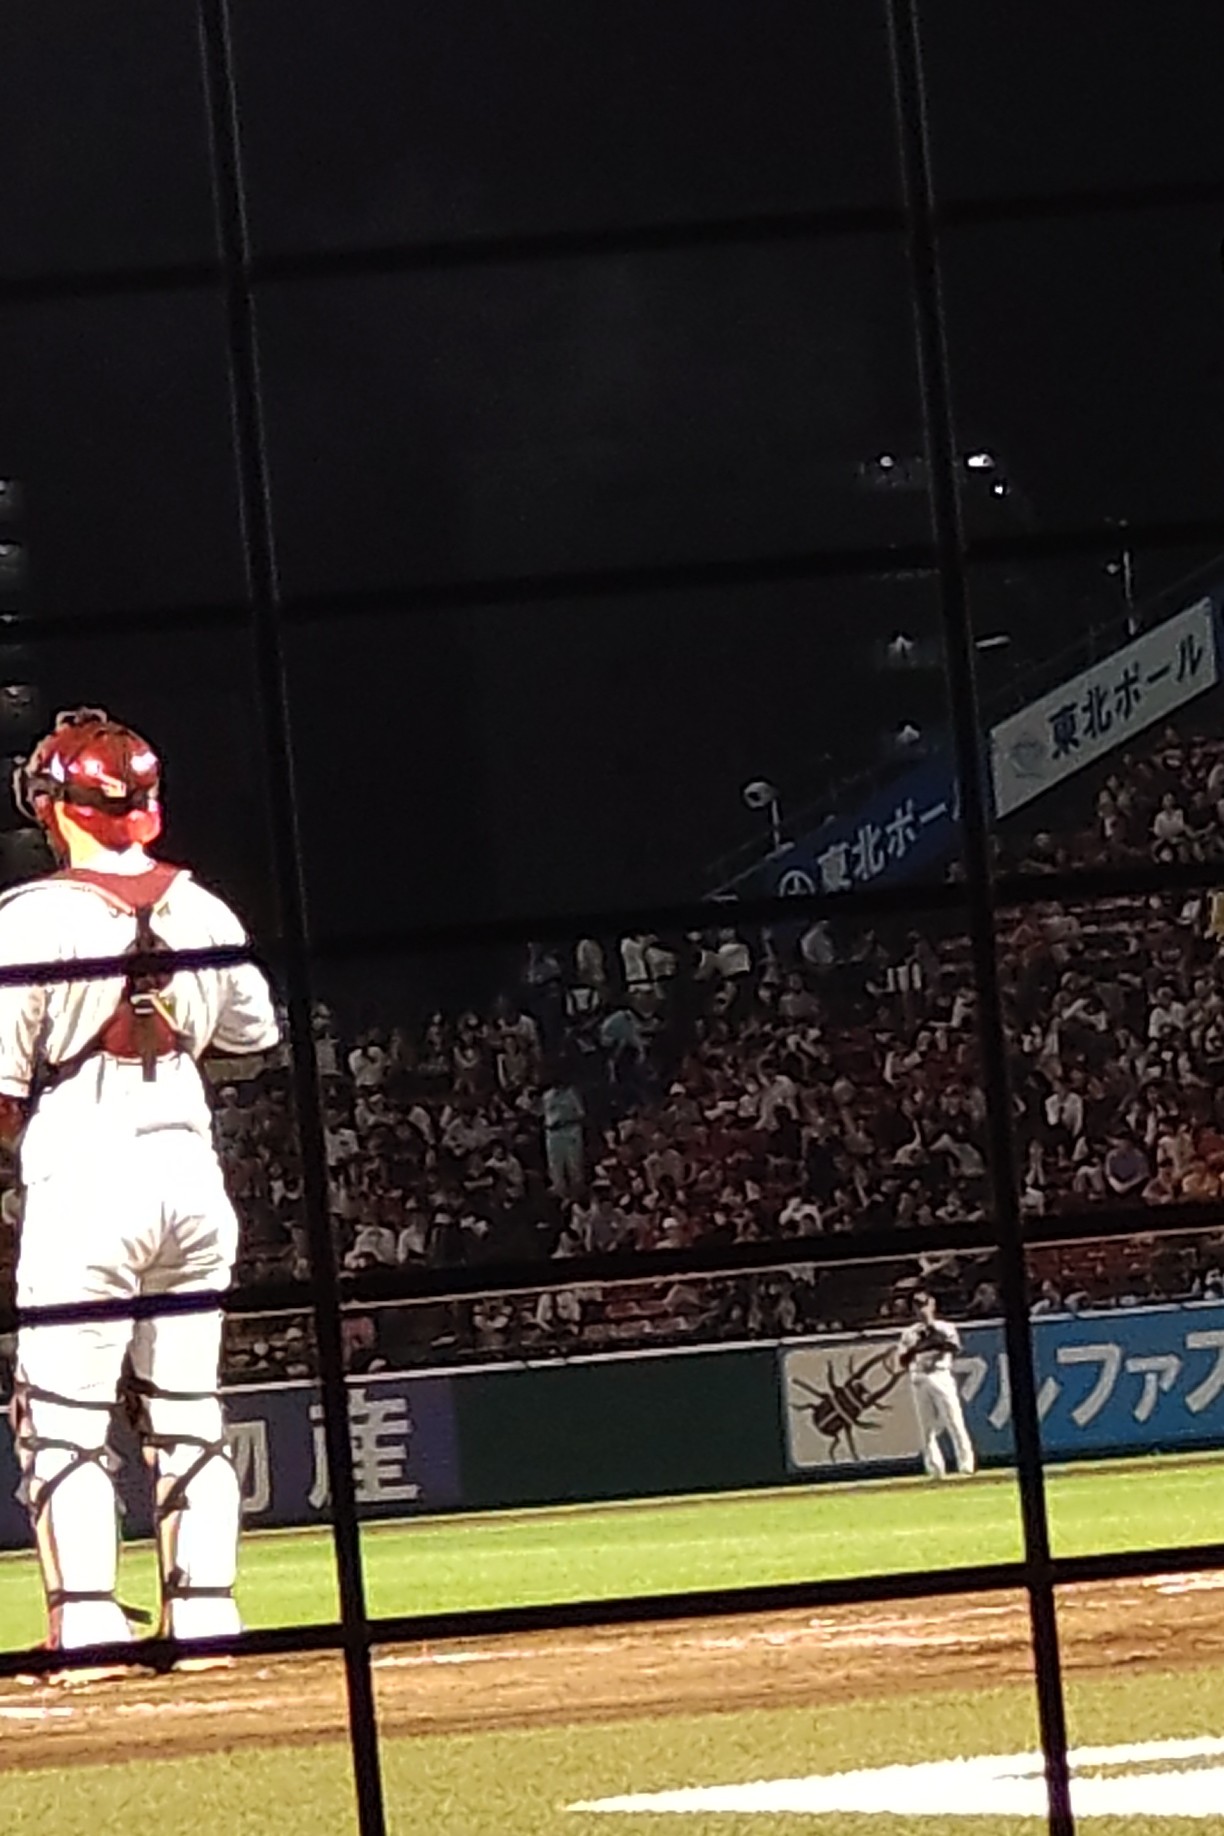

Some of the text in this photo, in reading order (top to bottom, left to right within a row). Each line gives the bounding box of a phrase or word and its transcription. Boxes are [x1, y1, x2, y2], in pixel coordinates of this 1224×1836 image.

[1048, 634, 1203, 759] 東北ボール
